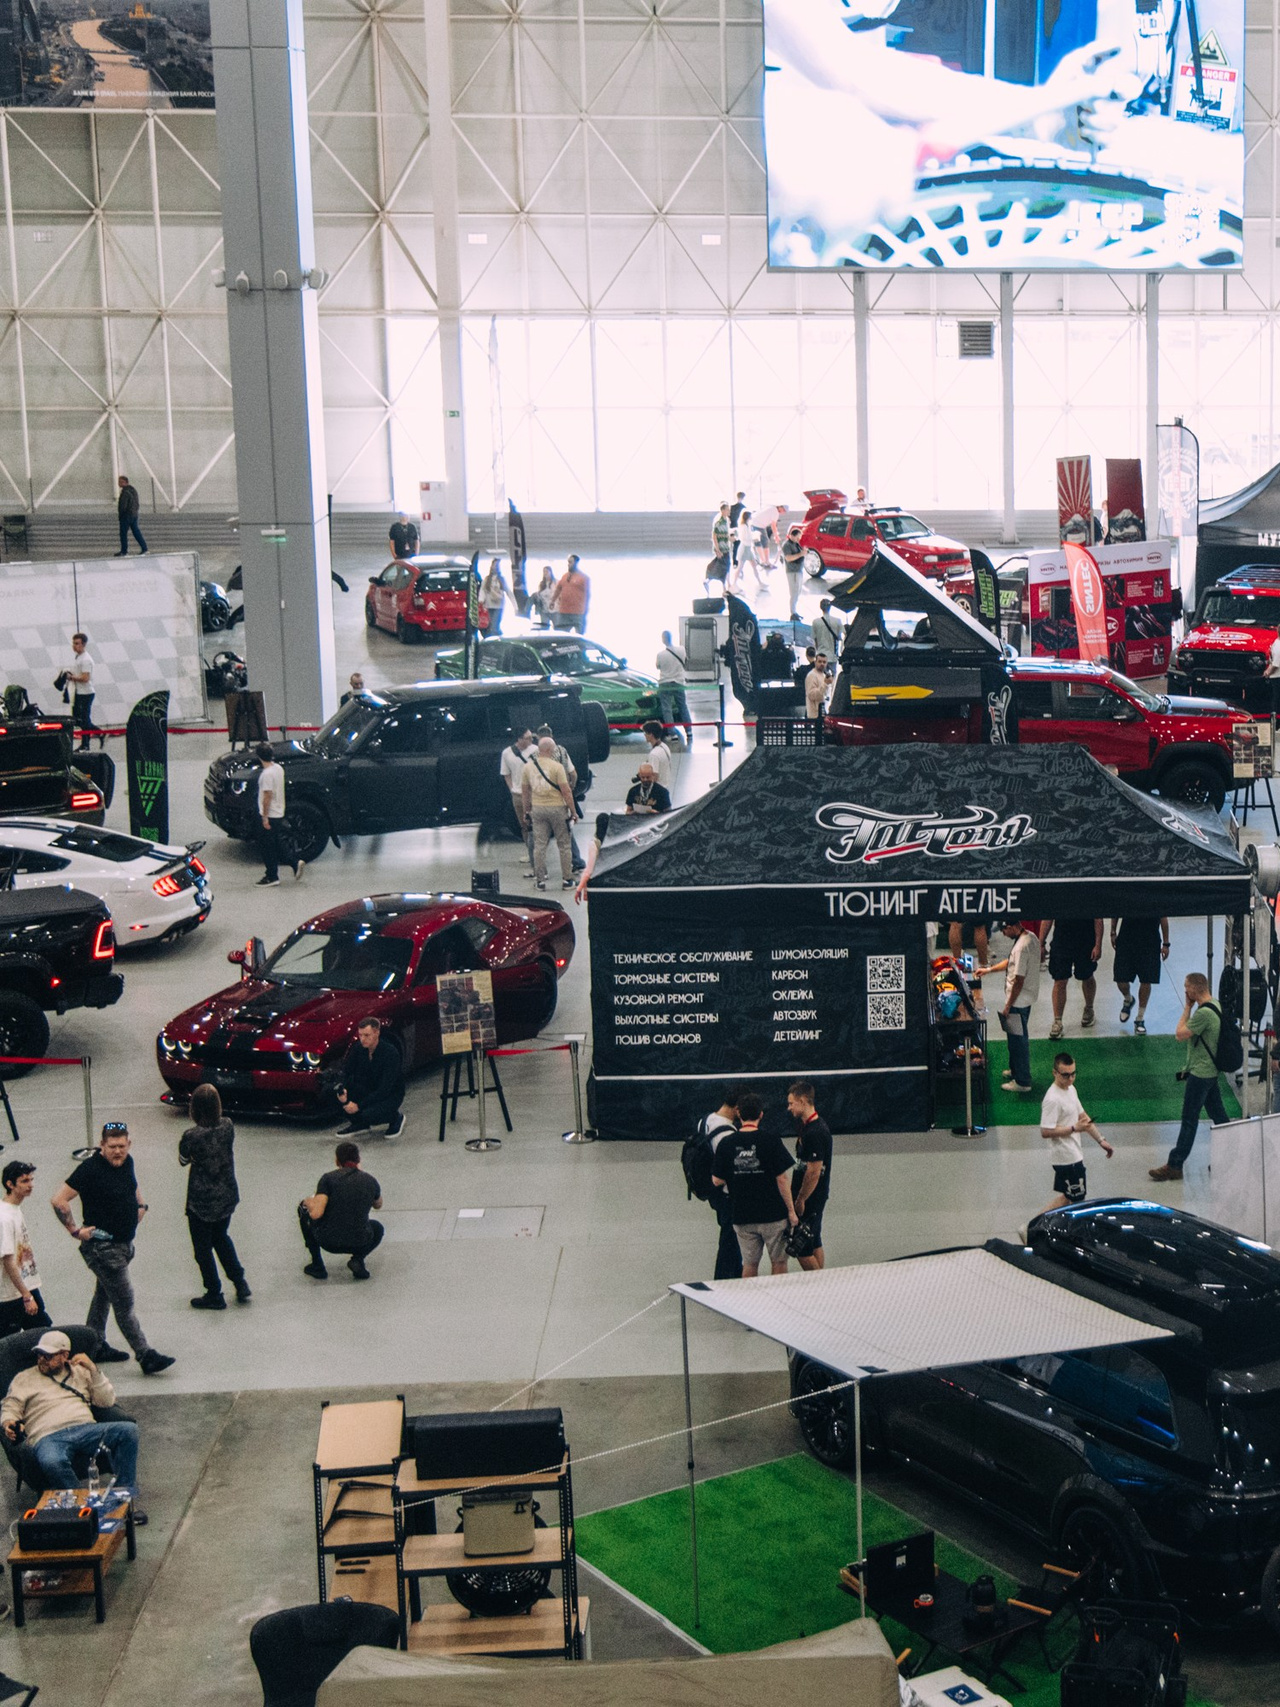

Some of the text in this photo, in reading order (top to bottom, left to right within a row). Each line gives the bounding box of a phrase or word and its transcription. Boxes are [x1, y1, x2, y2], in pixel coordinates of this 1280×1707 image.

[1201, 68, 1231, 81] ANGER
[824, 887, 1022, 917] ТЮНИНГ АТЕЛЬЕ
[613, 950, 753, 965] ТЕХНИЧЕСКОЕ ОБСЛУЖИВАНИЕ
[771, 948, 849, 961] ШУМОИЗОЛЯЦИЯ
[614, 972, 720, 985] ТОРМОЗНЫЕ СИСТЕМЫ
[771, 969, 808, 981] КАРБОН
[613, 992, 704, 1006] КУЗОВНОЙ РЕМОНТ
[772, 988, 814, 1001] ОКЛЕЙКА
[615, 1013, 719, 1025] ВЫХЛОПНЫЕ СИСТЕМЫ
[773, 1010, 818, 1021] АВТОЗВУК
[615, 1033, 701, 1046] ПОШИВ САЛОНОВ
[773, 1029, 823, 1042] ДЕТЕЙЛИНГ
